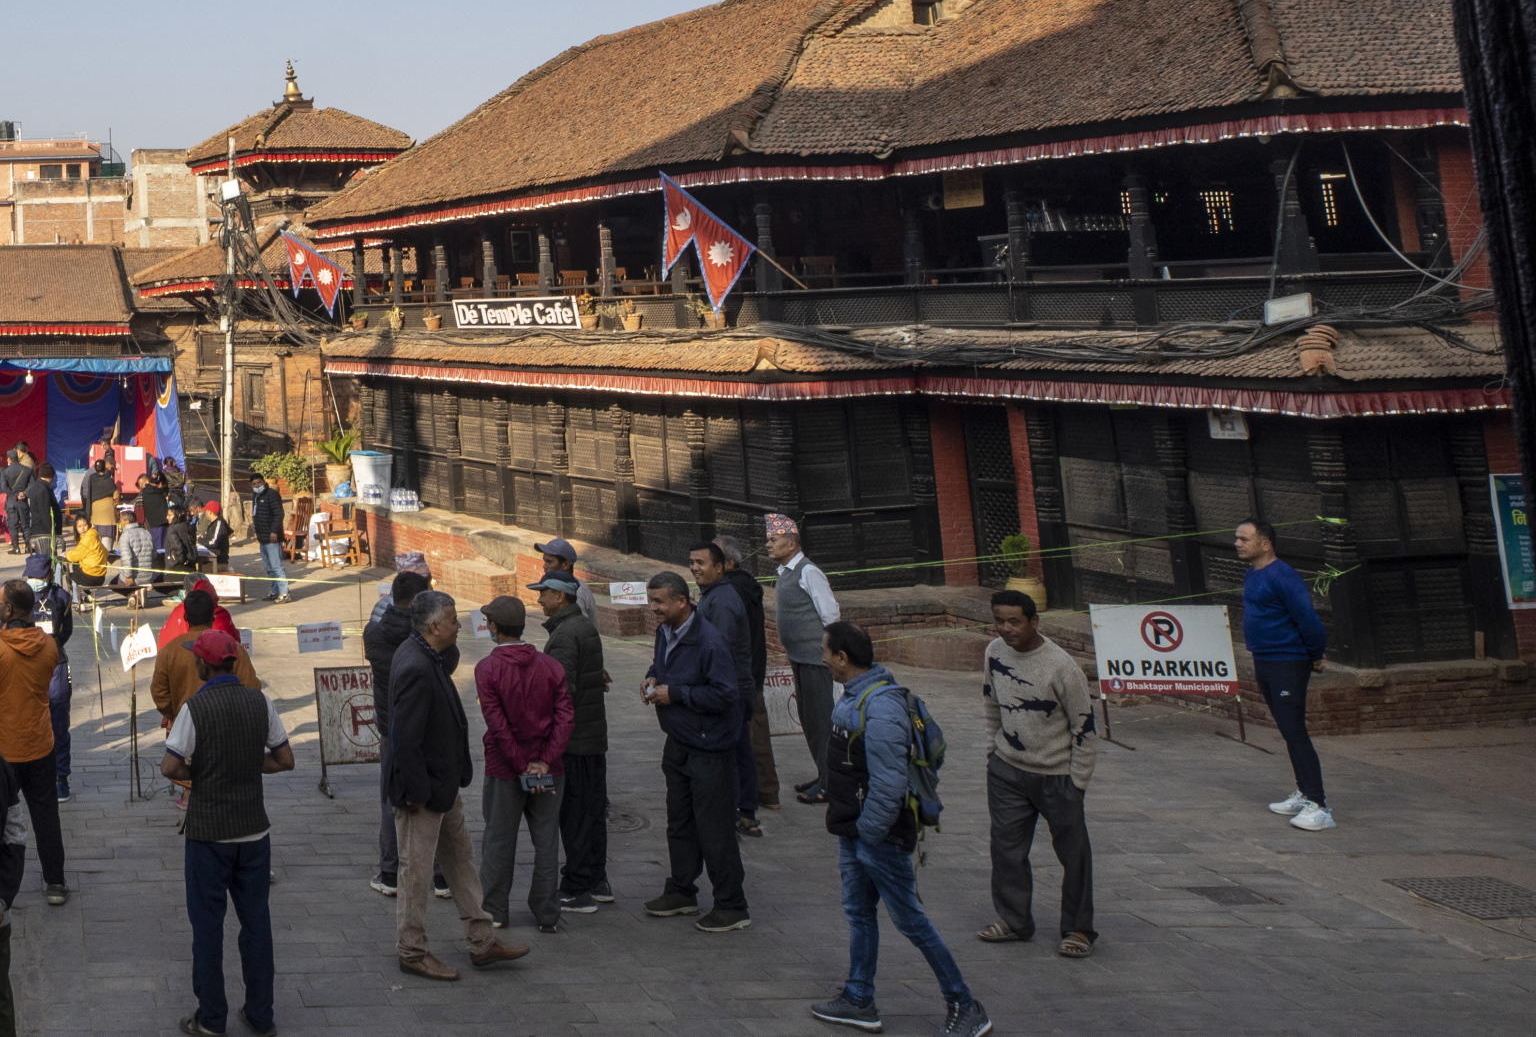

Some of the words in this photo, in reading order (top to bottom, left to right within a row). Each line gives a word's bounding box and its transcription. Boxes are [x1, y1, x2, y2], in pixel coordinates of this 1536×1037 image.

[457, 304, 479, 325] Dé
[477, 303, 533, 327] Temple
[533, 302, 574, 325] Cafe
[1107, 659, 1135, 676] NO
[1140, 660, 1229, 678] PARKING
[320, 674, 339, 691] NO
[1126, 681, 1172, 692] Bhaktapur
[1175, 682, 1230, 693] Municipality
